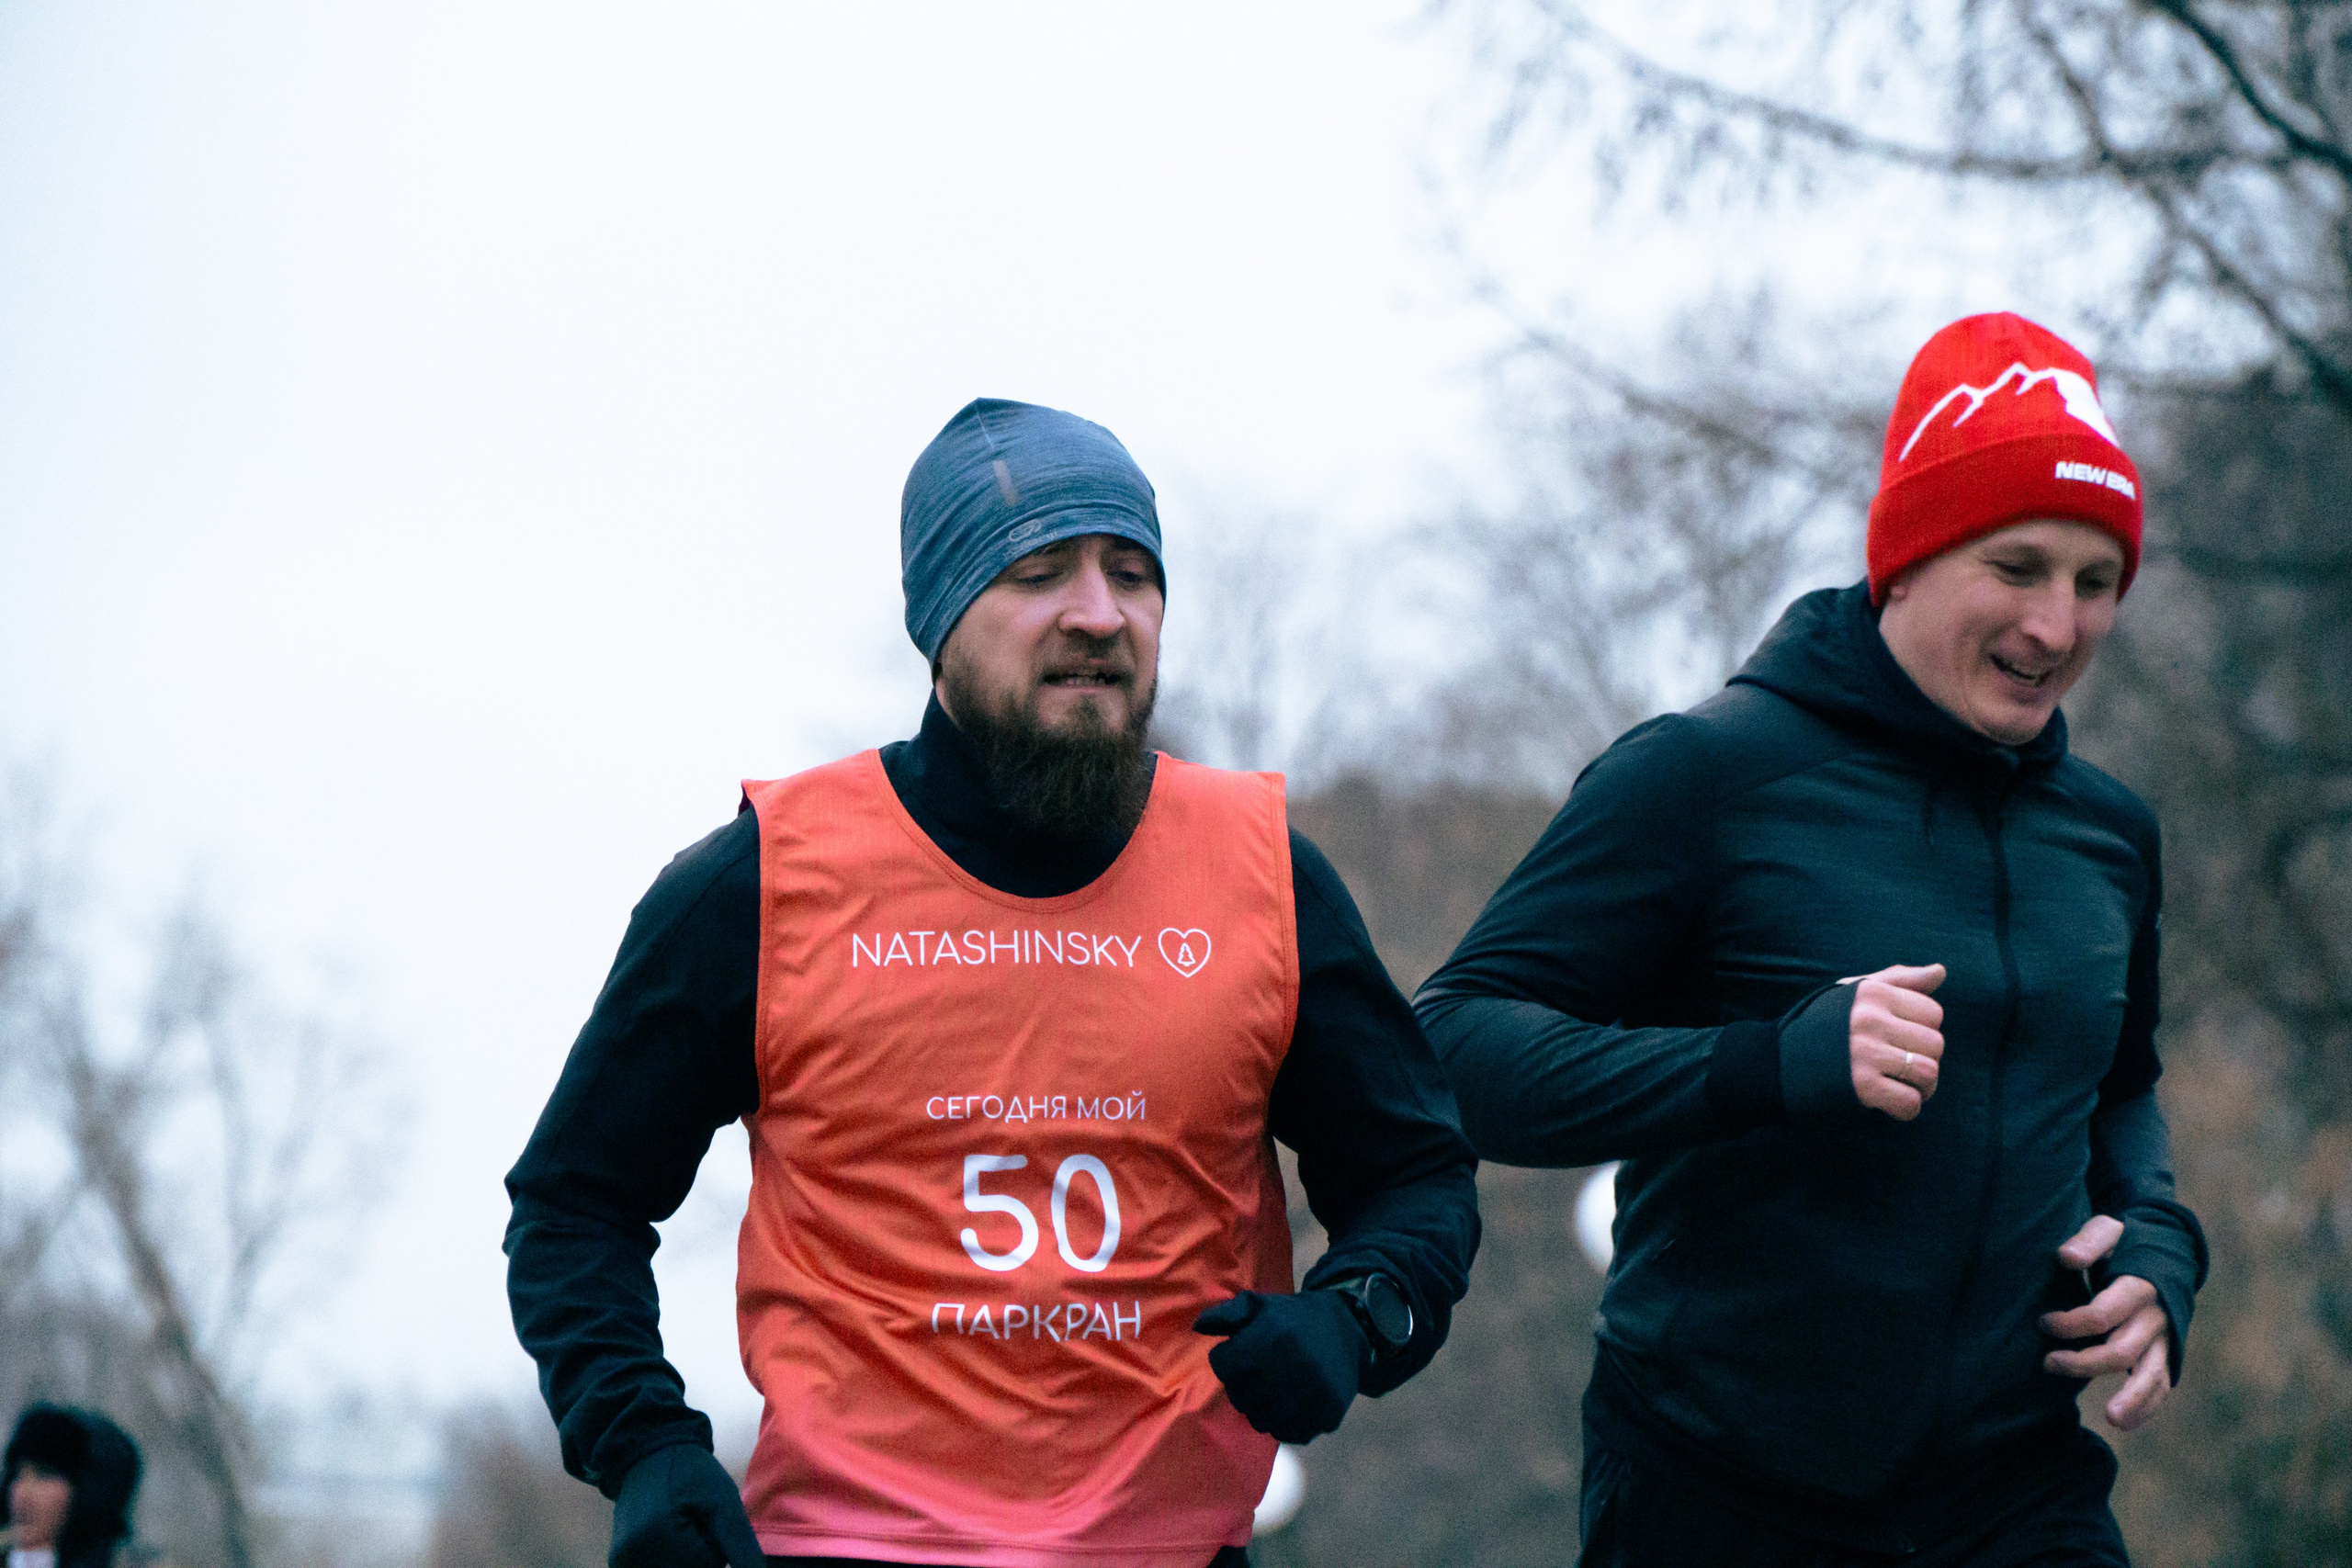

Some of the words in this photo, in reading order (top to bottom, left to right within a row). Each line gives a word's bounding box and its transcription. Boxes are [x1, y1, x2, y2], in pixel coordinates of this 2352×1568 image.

[2054, 461, 2107, 485] NEW
[853, 930, 1141, 967] NATASHINSKY
[926, 1095, 1067, 1123] СЕГОДНЯ
[1077, 1090, 1146, 1120] МОЙ
[960, 1154, 1121, 1272] 50
[932, 1300, 1141, 1342] ПАРКРАН
